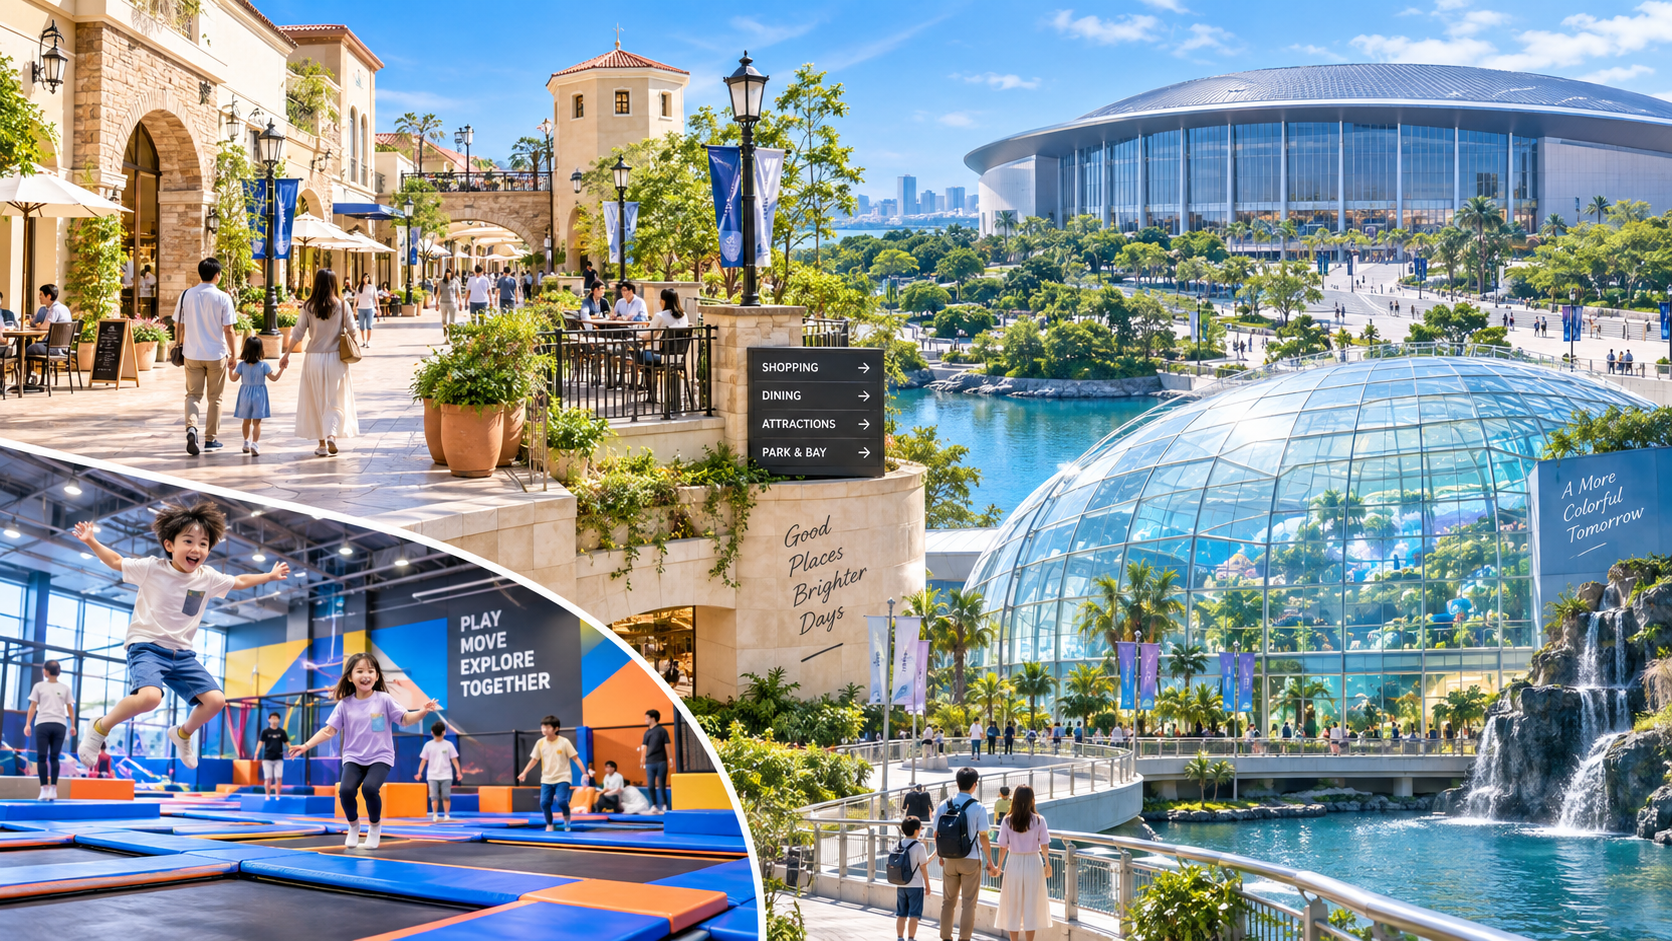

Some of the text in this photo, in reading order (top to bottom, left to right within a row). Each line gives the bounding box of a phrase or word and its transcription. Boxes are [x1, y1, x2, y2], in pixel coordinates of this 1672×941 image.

[762, 362, 819, 373] SHOPPING
[762, 390, 802, 401] DINING
[761, 418, 836, 429] ATTRACTIONS
[762, 447, 827, 458] PARK & BAY
[1561, 472, 1617, 500] A More
[1563, 486, 1624, 522] Colorful
[784, 515, 832, 548] Good
[1566, 507, 1645, 543] Tomorrow
[789, 547, 844, 578] Places
[793, 567, 868, 608] Brighter
[460, 609, 502, 632] PLAY
[799, 606, 844, 636] Days
[460, 631, 507, 654] MOVE
[460, 650, 535, 675] EXPLORE
[460, 672, 551, 697] TOGETHER
